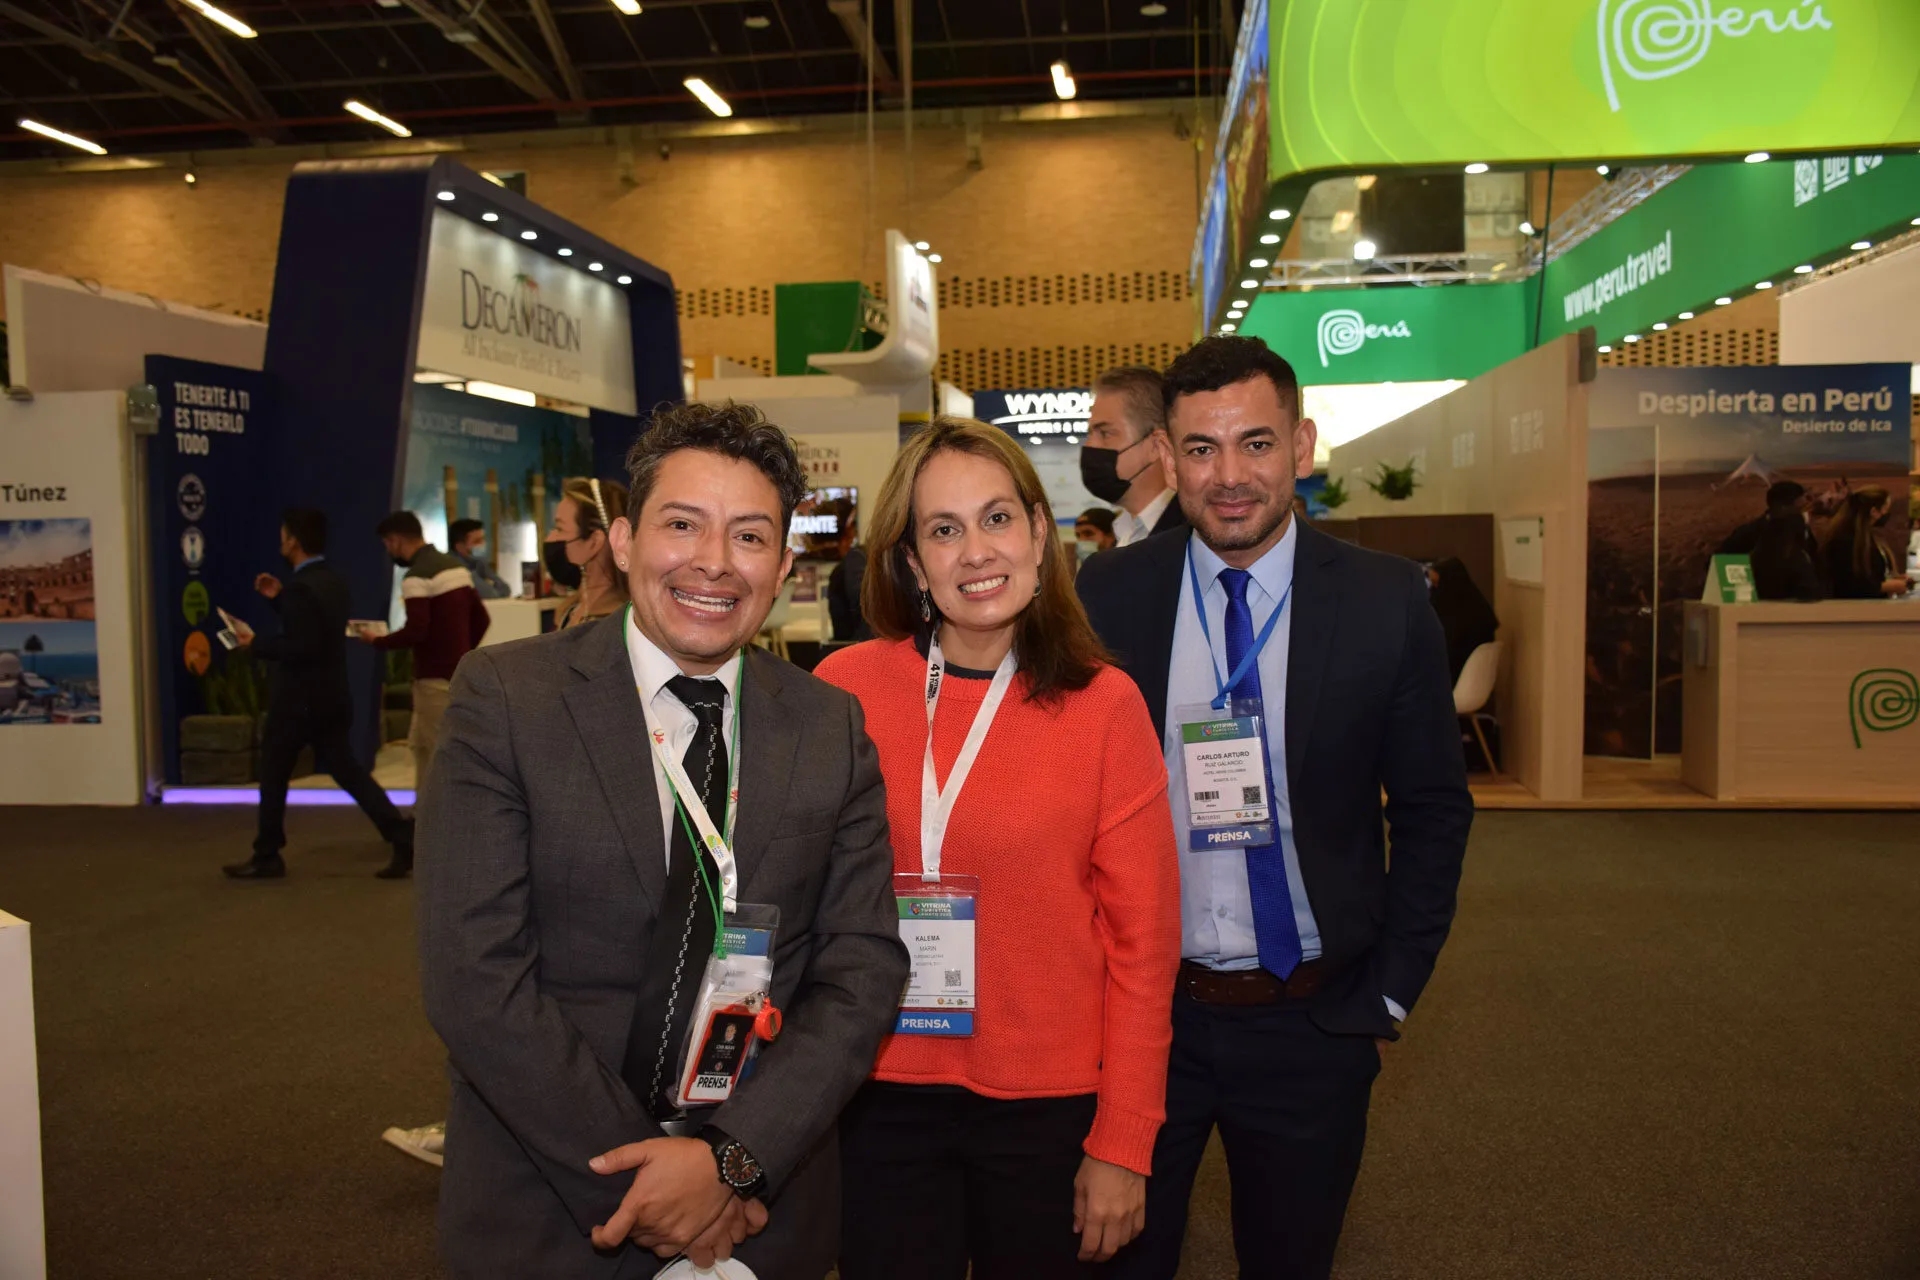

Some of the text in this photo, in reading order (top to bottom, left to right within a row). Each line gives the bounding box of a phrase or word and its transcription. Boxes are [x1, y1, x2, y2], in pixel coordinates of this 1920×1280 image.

[1563, 229, 1672, 322] www.peru.travel
[459, 268, 582, 352] DECAMERON
[174, 382, 250, 412] TENERTE A TI
[1638, 386, 1892, 417] Despierta en Perú
[174, 406, 244, 434] ES TENERLO
[1782, 418, 1892, 433] Desierto de Ica
[176, 432, 209, 456] TODO
[1, 484, 67, 502] Túnez
[930, 663, 941, 677] 41
[1196, 750, 1250, 761] CARLOS ARTURO
[1208, 831, 1251, 843] PRENSA
[902, 1018, 951, 1029] PRENSA
[696, 1076, 728, 1089] PRENSA
